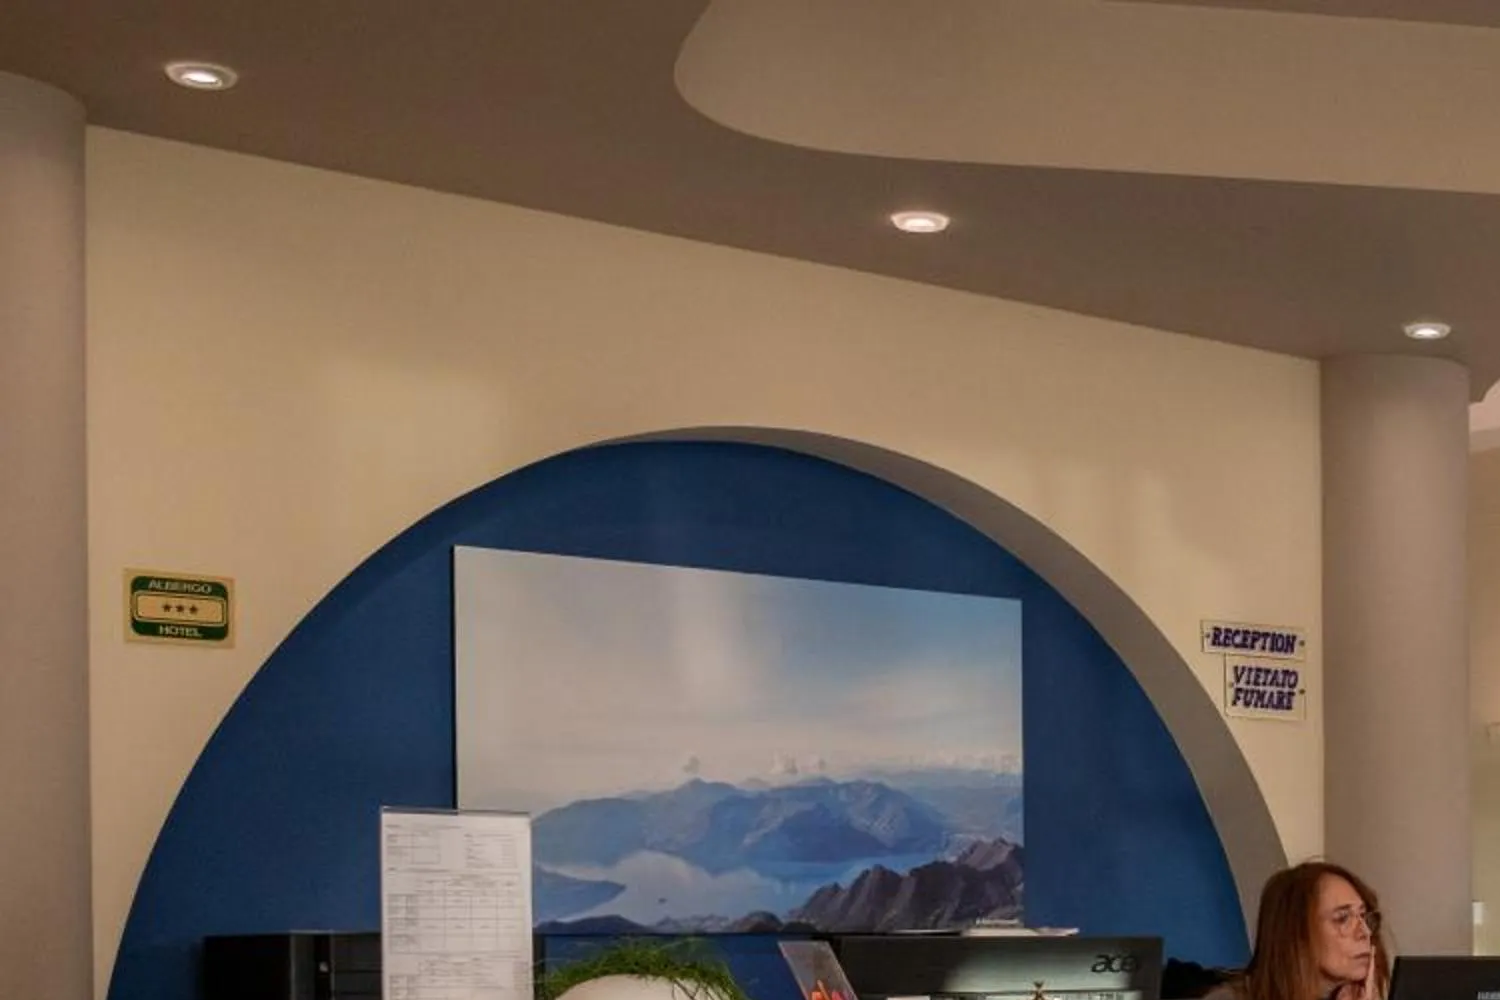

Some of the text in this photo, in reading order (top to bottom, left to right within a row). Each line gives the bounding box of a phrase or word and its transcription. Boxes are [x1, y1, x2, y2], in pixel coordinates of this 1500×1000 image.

[159, 625, 203, 637] HOTEL
[1211, 626, 1297, 653] RECEPTION
[1233, 666, 1298, 688] VIETATO
[1231, 687, 1295, 710] FUMARE
[1091, 954, 1140, 973] ace
